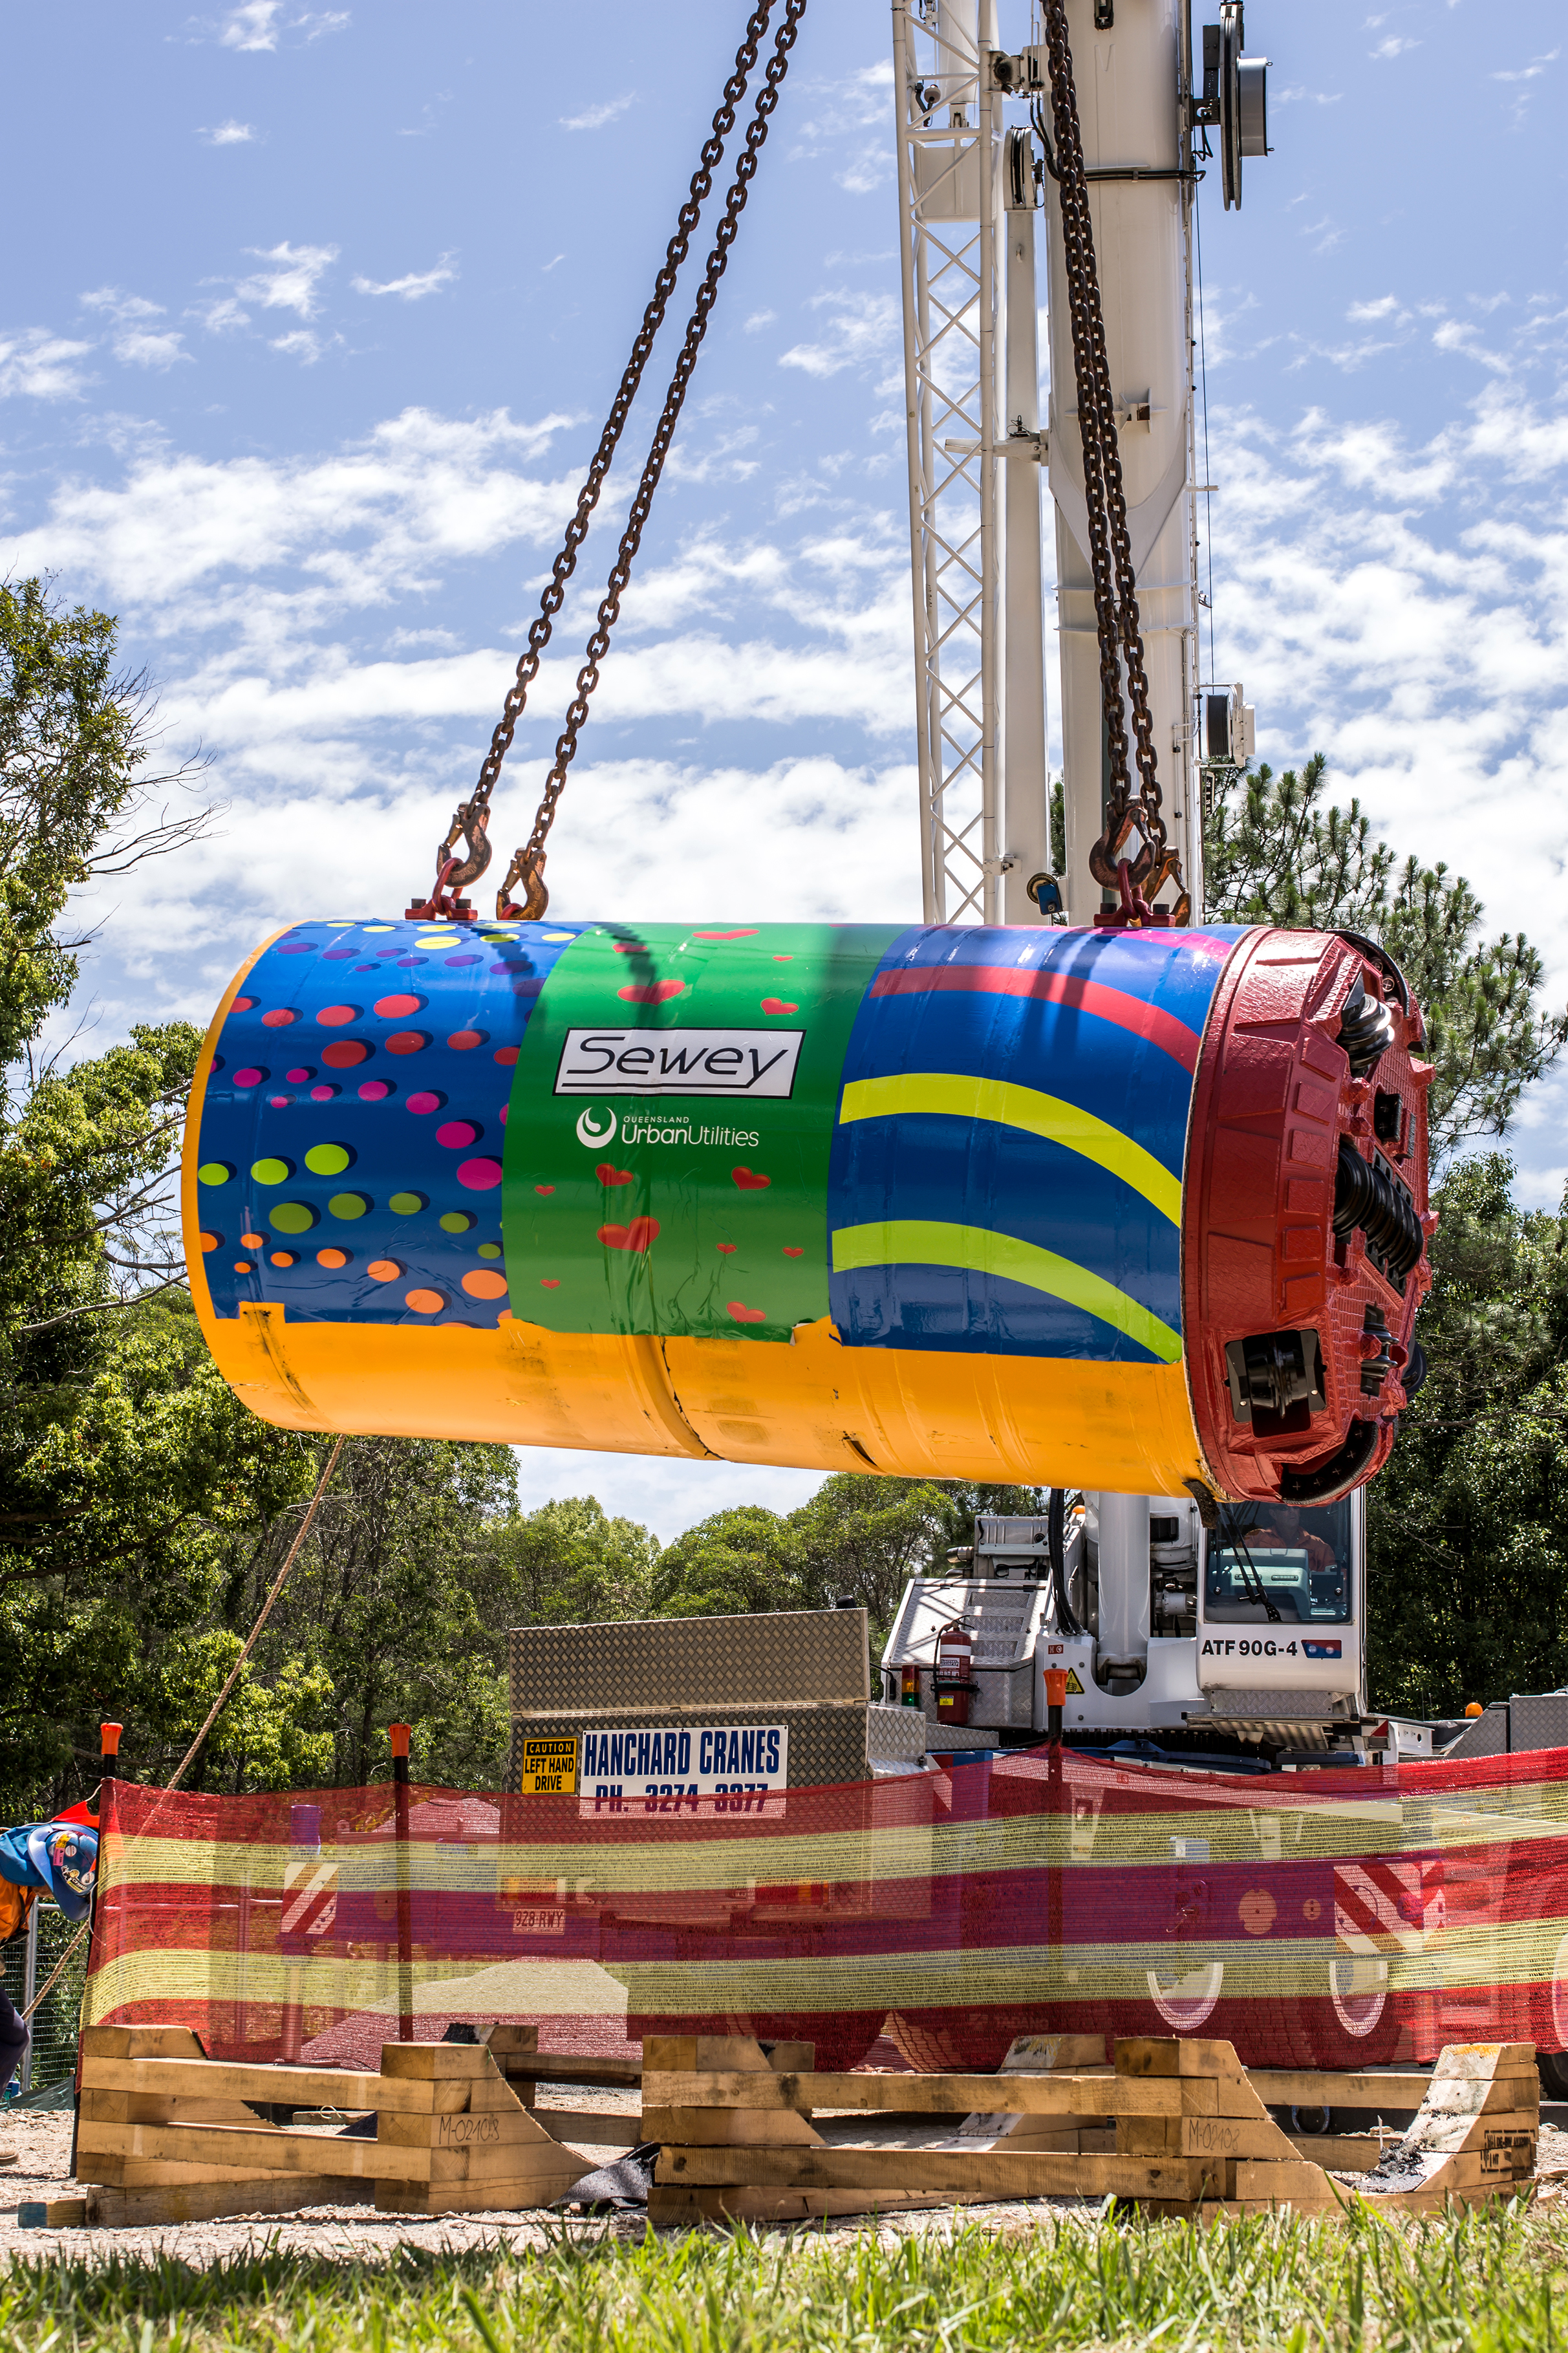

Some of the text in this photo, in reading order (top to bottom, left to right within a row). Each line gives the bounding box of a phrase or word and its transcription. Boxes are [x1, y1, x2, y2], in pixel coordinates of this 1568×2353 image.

[561, 1036, 789, 1089] Sewey
[621, 1124, 759, 1147] UrbanUtilities
[1201, 1640, 1298, 1656] ATF 90G-4
[530, 1742, 572, 1753] CAUTION
[584, 1729, 780, 1776] HANCHARD CRANES
[524, 1757, 574, 1773] LEFT HAND
[535, 1775, 562, 1790] DRIVE
[595, 1783, 768, 1812] PH. 3274 3377
[439, 2114, 500, 2145] M-02108
